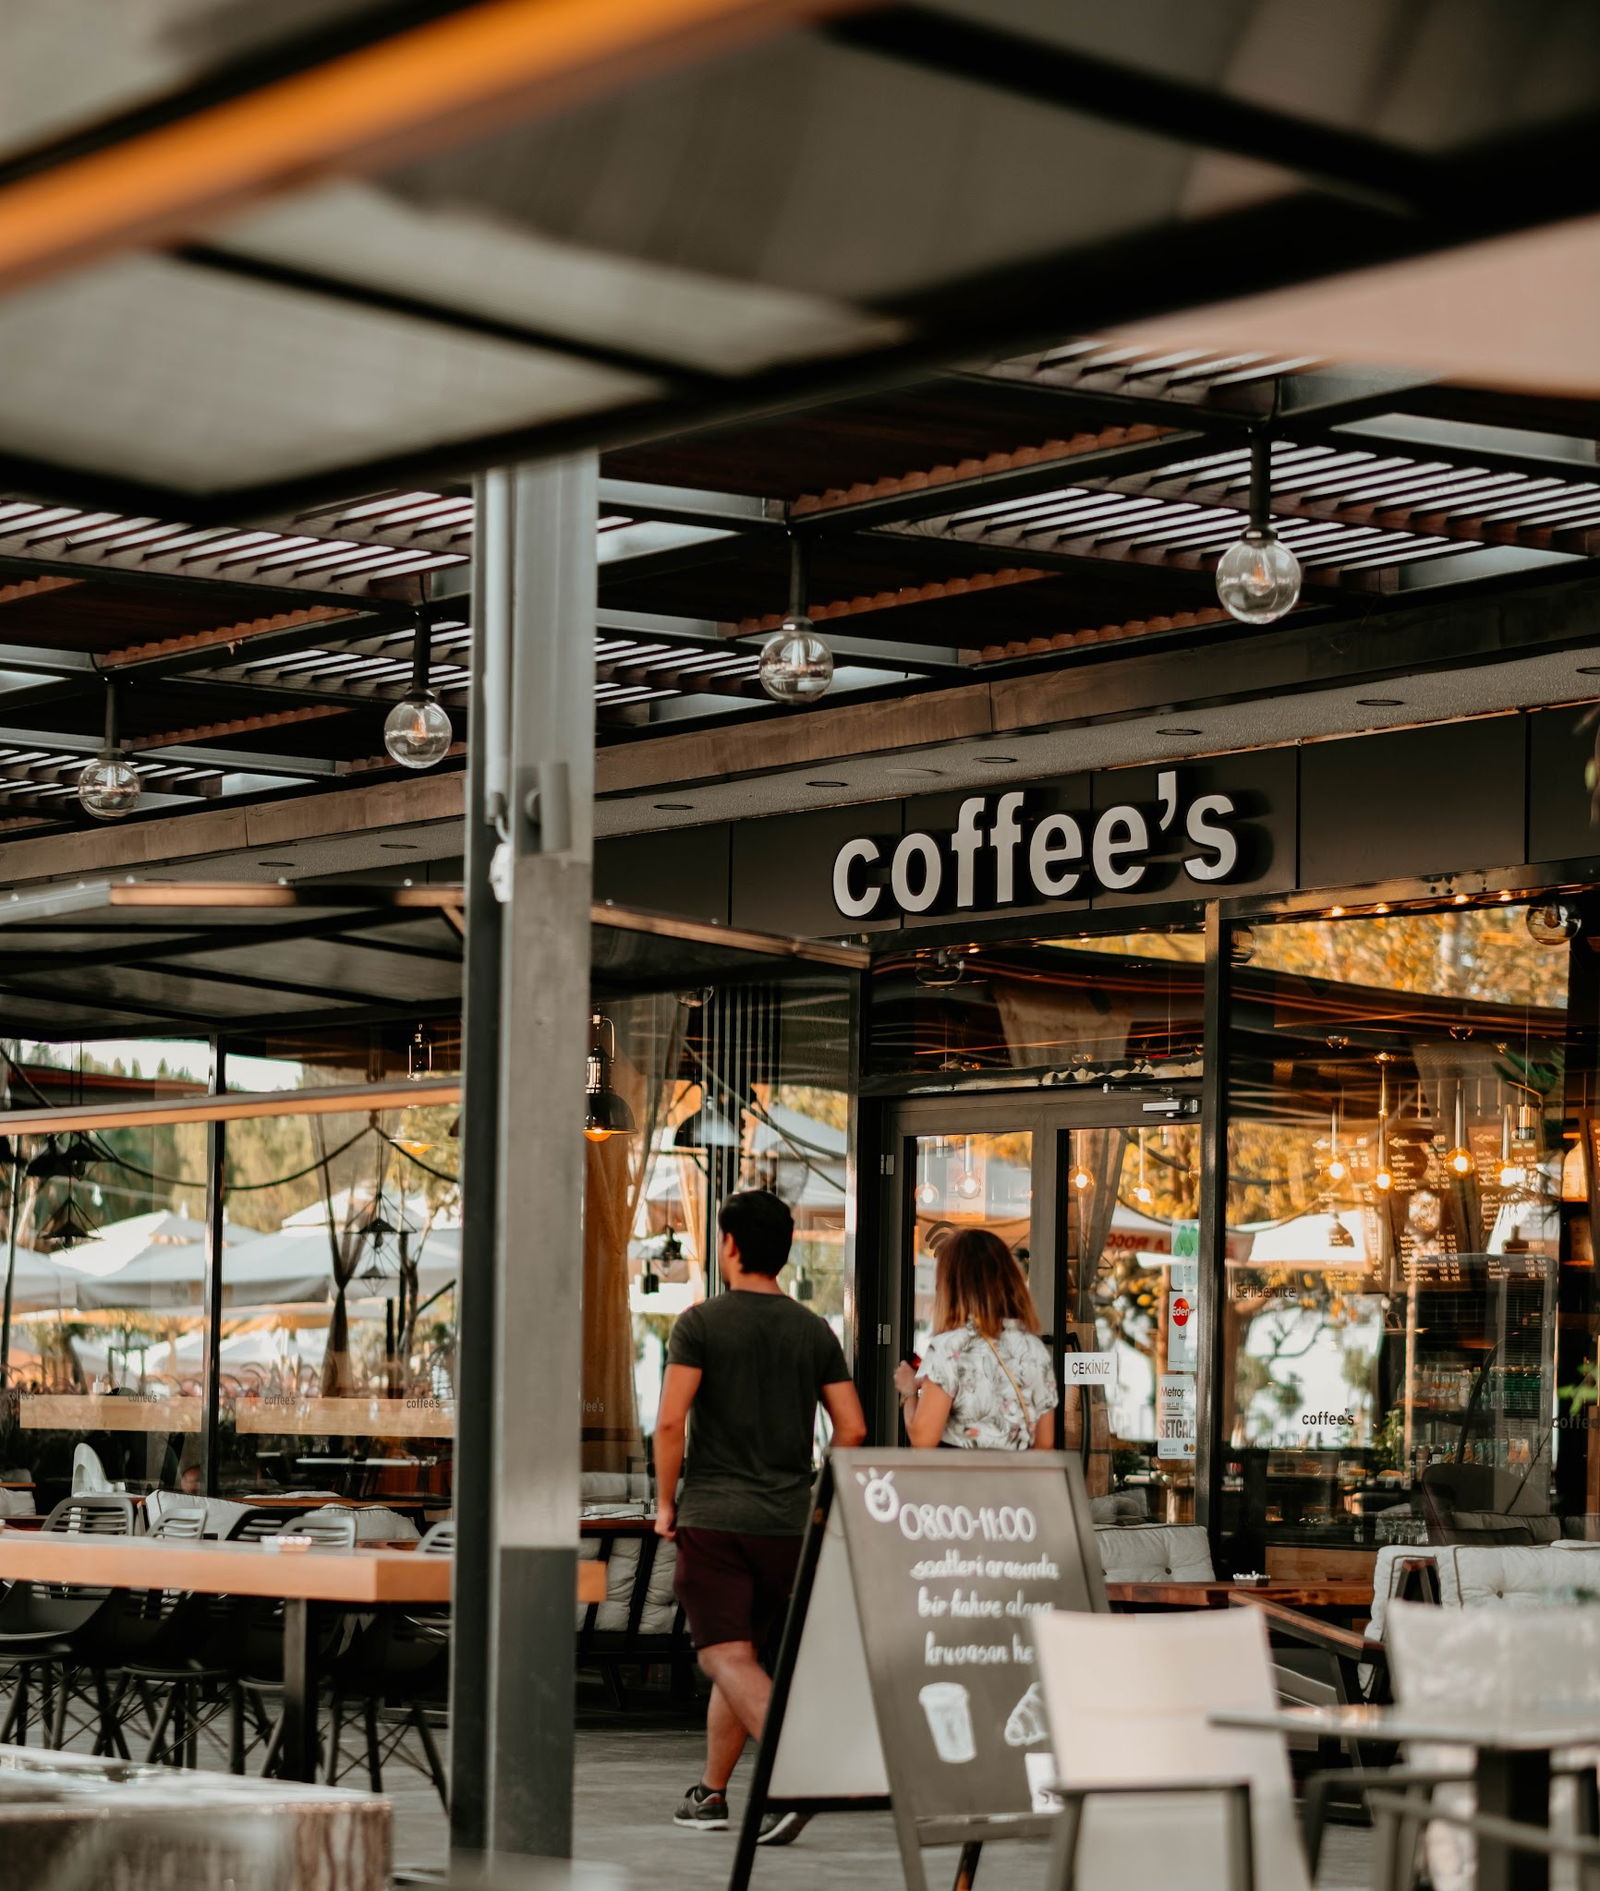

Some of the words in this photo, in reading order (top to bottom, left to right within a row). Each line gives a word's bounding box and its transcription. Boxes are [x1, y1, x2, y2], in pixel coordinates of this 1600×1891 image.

[833, 770, 1239, 919] coffee's
[1071, 1359, 1110, 1378] ÇEKİNİZ
[1301, 1407, 1355, 1426] coffee's
[910, 1548, 984, 1580] saatleri
[918, 1586, 949, 1617] bir
[950, 1588, 1003, 1618] kahve
[925, 1630, 1009, 1666] kruvasan
